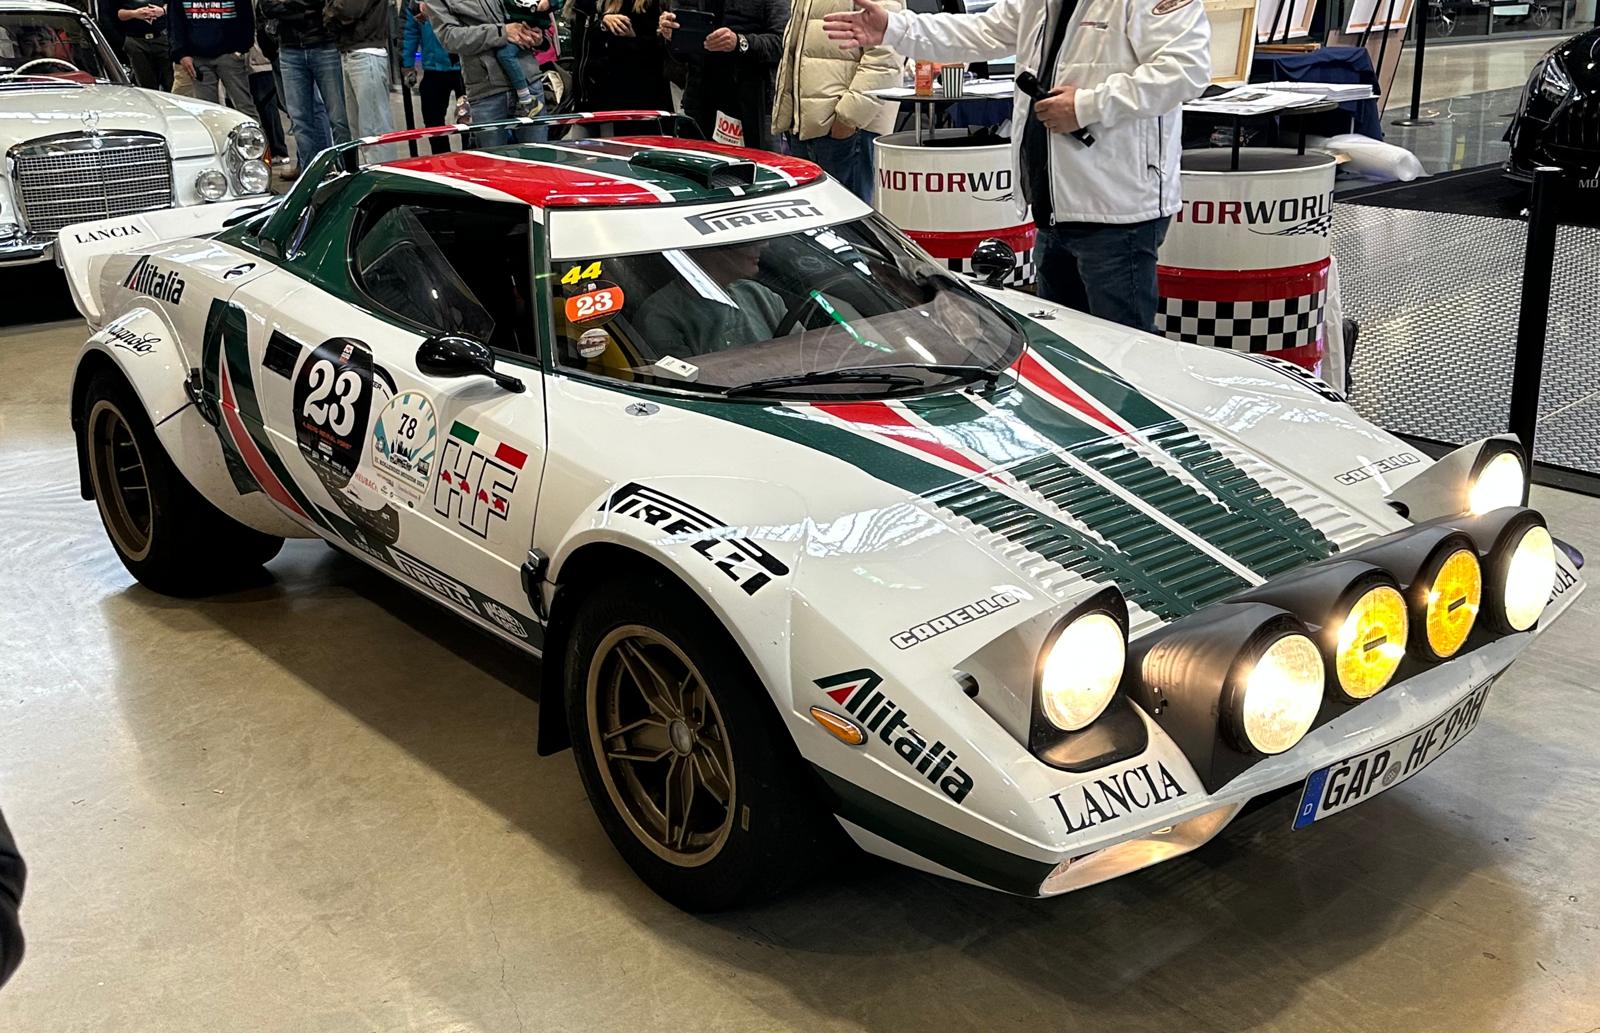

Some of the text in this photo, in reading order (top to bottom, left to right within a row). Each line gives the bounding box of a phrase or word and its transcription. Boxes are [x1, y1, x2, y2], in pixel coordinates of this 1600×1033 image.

[192, 12, 222, 20] RACING
[74, 225, 142, 244] LANCIA
[684, 199, 824, 236] PIRELLI
[123, 255, 186, 305] Alitalia
[561, 261, 602, 285] 44
[576, 292, 613, 317] 23
[303, 359, 362, 437] 23
[397, 413, 418, 440] 78
[434, 438, 518, 540] HF
[597, 481, 790, 597] PIRELLI
[385, 545, 481, 616] PIRELLI
[890, 591, 1021, 650] CARELLO
[812, 668, 974, 805] Alitalia
[1322, 685, 1489, 811] GAP HF 99H
[1048, 760, 1188, 835] LANCIA
[1303, 803, 1314, 817] D
